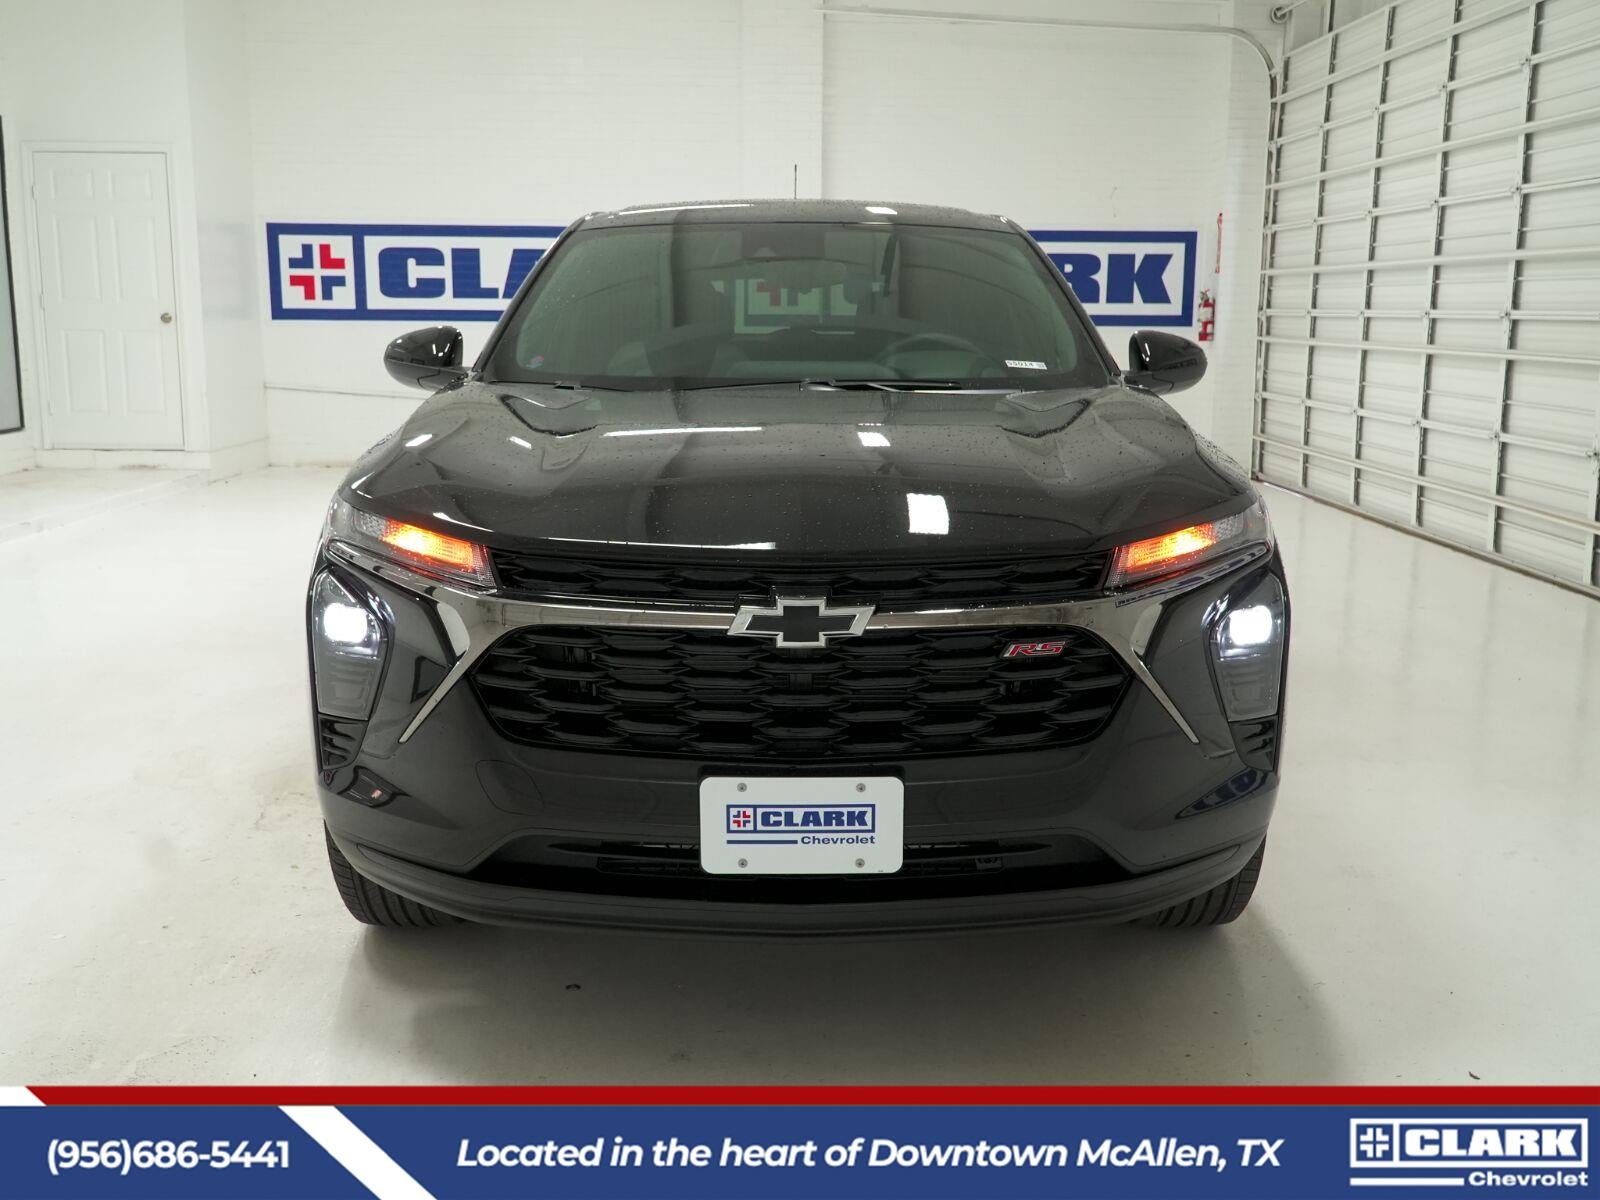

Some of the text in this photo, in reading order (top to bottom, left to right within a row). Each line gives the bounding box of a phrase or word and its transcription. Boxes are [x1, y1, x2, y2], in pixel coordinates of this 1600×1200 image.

[1003, 641, 1066, 657] RS
[761, 810, 869, 827] CLARK
[801, 835, 876, 844] Chevrolet
